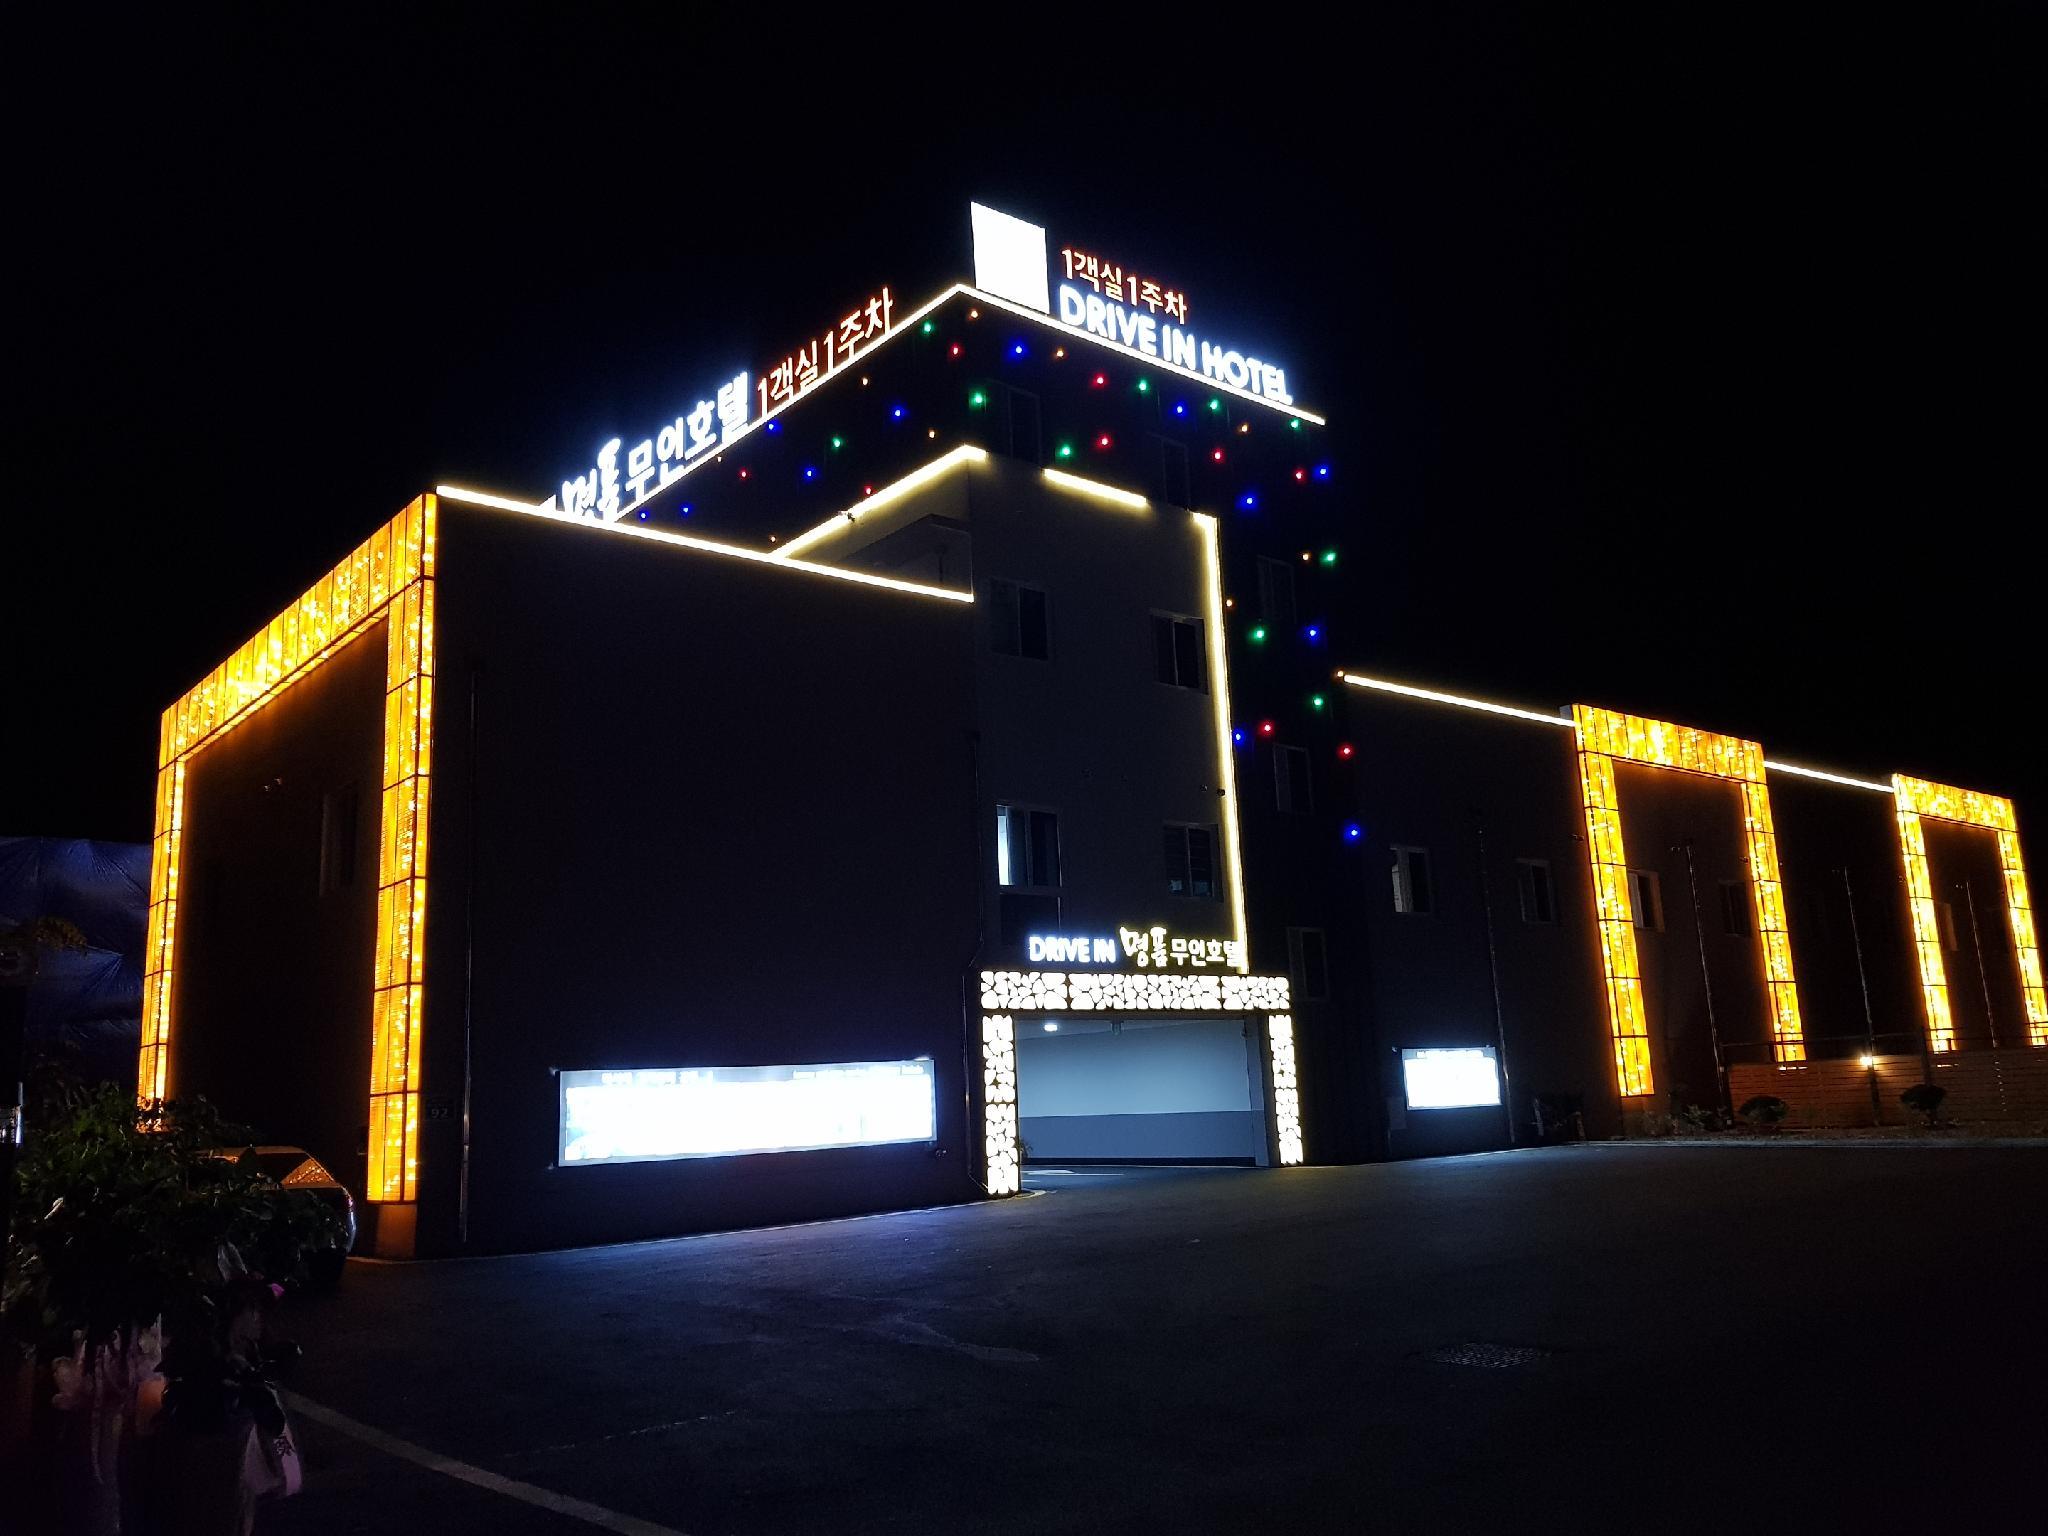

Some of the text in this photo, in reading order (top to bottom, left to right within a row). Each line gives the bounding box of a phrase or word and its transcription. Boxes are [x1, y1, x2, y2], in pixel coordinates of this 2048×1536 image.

[1059, 284, 1293, 405] DRIVE IN HOTEL
[625, 371, 749, 499] 무인호텔
[1028, 926, 1243, 968] DRIVE IN 명품 무인호텔
